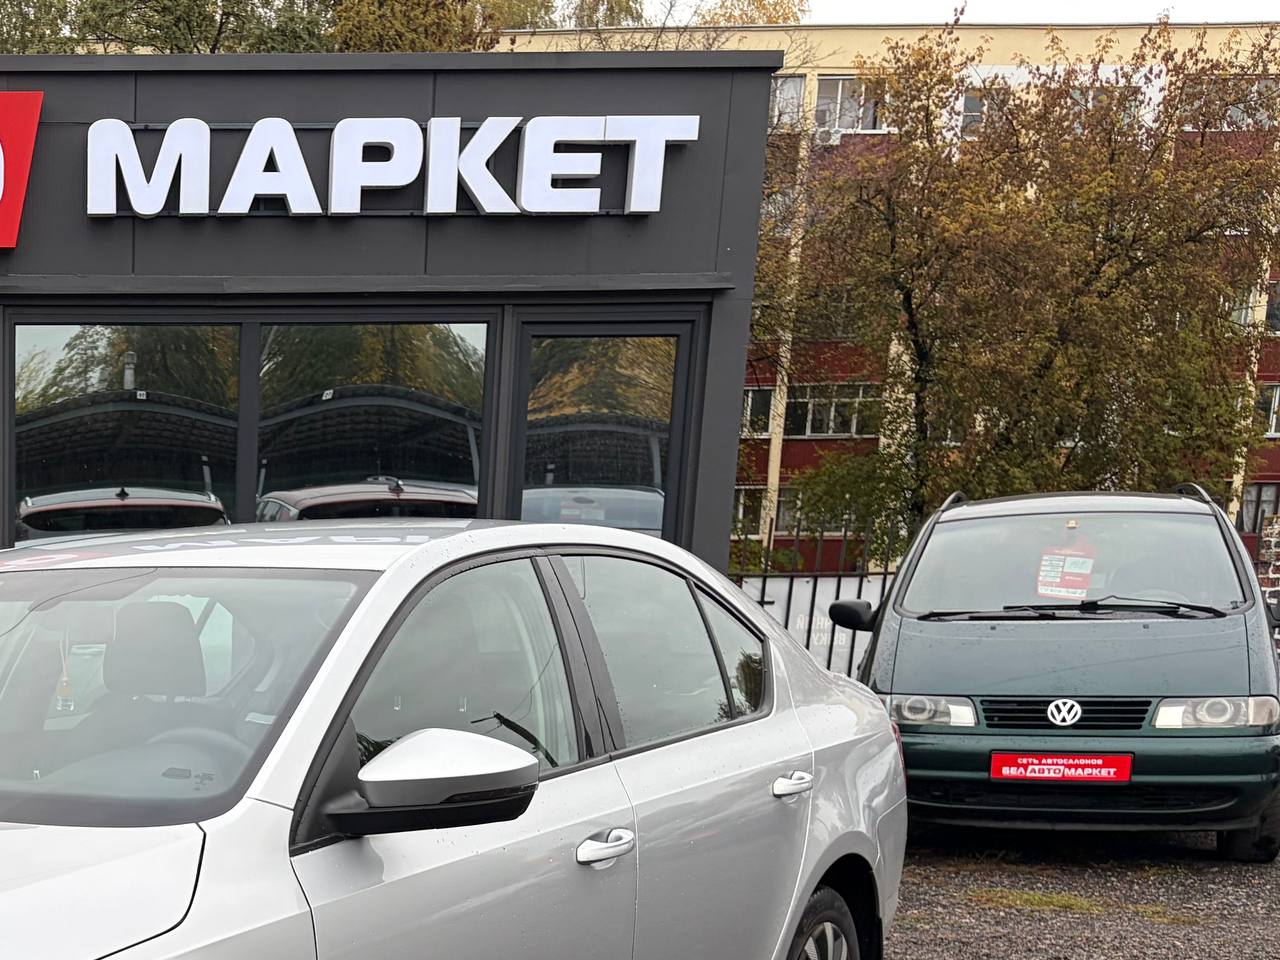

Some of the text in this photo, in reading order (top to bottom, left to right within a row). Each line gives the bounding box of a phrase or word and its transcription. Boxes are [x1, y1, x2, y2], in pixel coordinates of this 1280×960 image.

[87, 115, 699, 218] МАРКЕТ
[1002, 767, 1116, 776] БЕЛ АВТО МАРКЕТ
